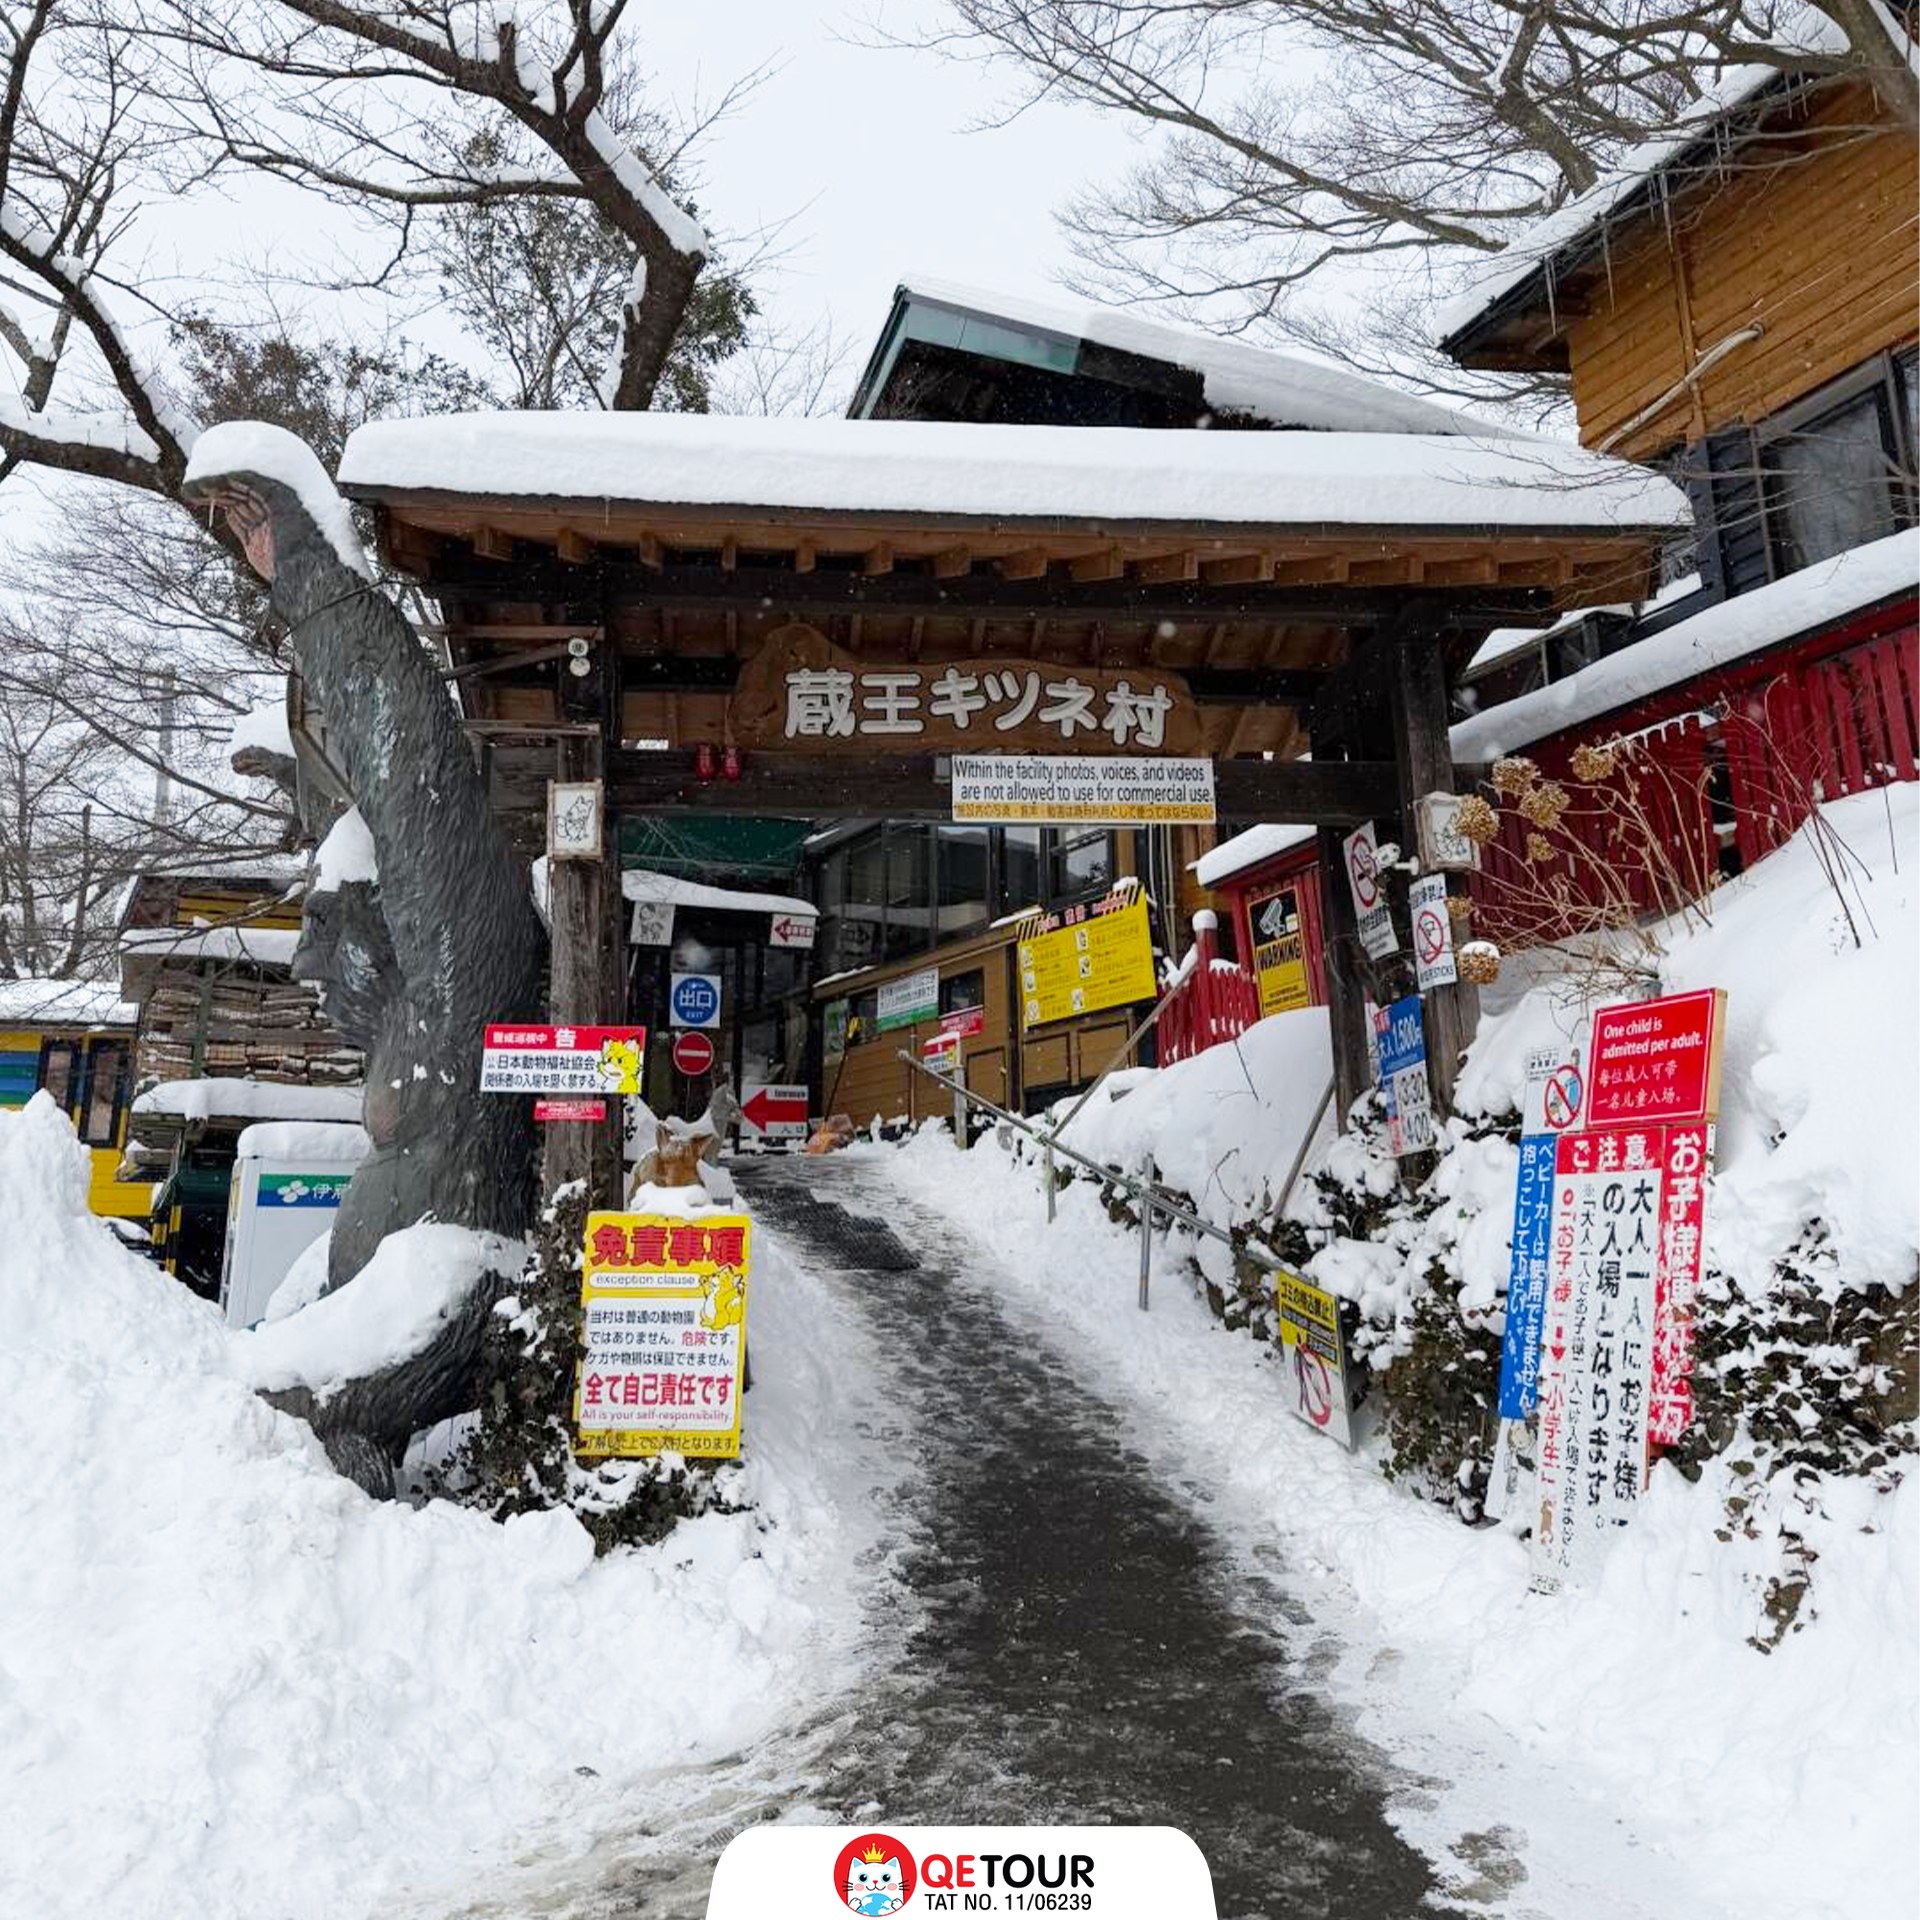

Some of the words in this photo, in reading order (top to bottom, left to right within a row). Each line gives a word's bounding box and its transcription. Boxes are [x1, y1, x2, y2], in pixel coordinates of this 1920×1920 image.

[784, 667, 1172, 748] 蔵王キツネ村
[954, 757, 993, 779] Within
[996, 760, 1014, 779] the
[1016, 758, 1053, 783] facility
[1055, 761, 1098, 783] photos,
[1102, 761, 1140, 783] voices,
[1142, 761, 1164, 780] and
[1167, 761, 1204, 781] videos
[961, 786, 981, 799] are
[984, 785, 1004, 799] not
[1007, 783, 1054, 799] allowed
[1058, 784, 1070, 800] to
[1073, 787, 1095, 800] use
[1097, 783, 1114, 800] for
[1117, 783, 1186, 801] commercial
[679, 988, 712, 1008] 出口
[686, 1011, 704, 1019] EXIT
[1604, 1024, 1625, 1039] One
[1626, 1017, 1652, 1036] child
[1653, 1016, 1663, 1031] is
[554, 1029, 577, 1049] 告
[1602, 1038, 1650, 1059] admitted
[1650, 1039, 1669, 1056] per
[1670, 1031, 1703, 1049] adult.
[1571, 1134, 1647, 1171] ご注意
[591, 1225, 745, 1267] 免責事項
[596, 1275, 653, 1288] exception
[657, 1274, 695, 1286] clause
[590, 1310, 695, 1325] 当村は普通の動物園
[585, 1373, 734, 1406] 全て自己責任です
[582, 1410, 597, 1420] All
[600, 1411, 607, 1420] is
[609, 1412, 634, 1422] your
